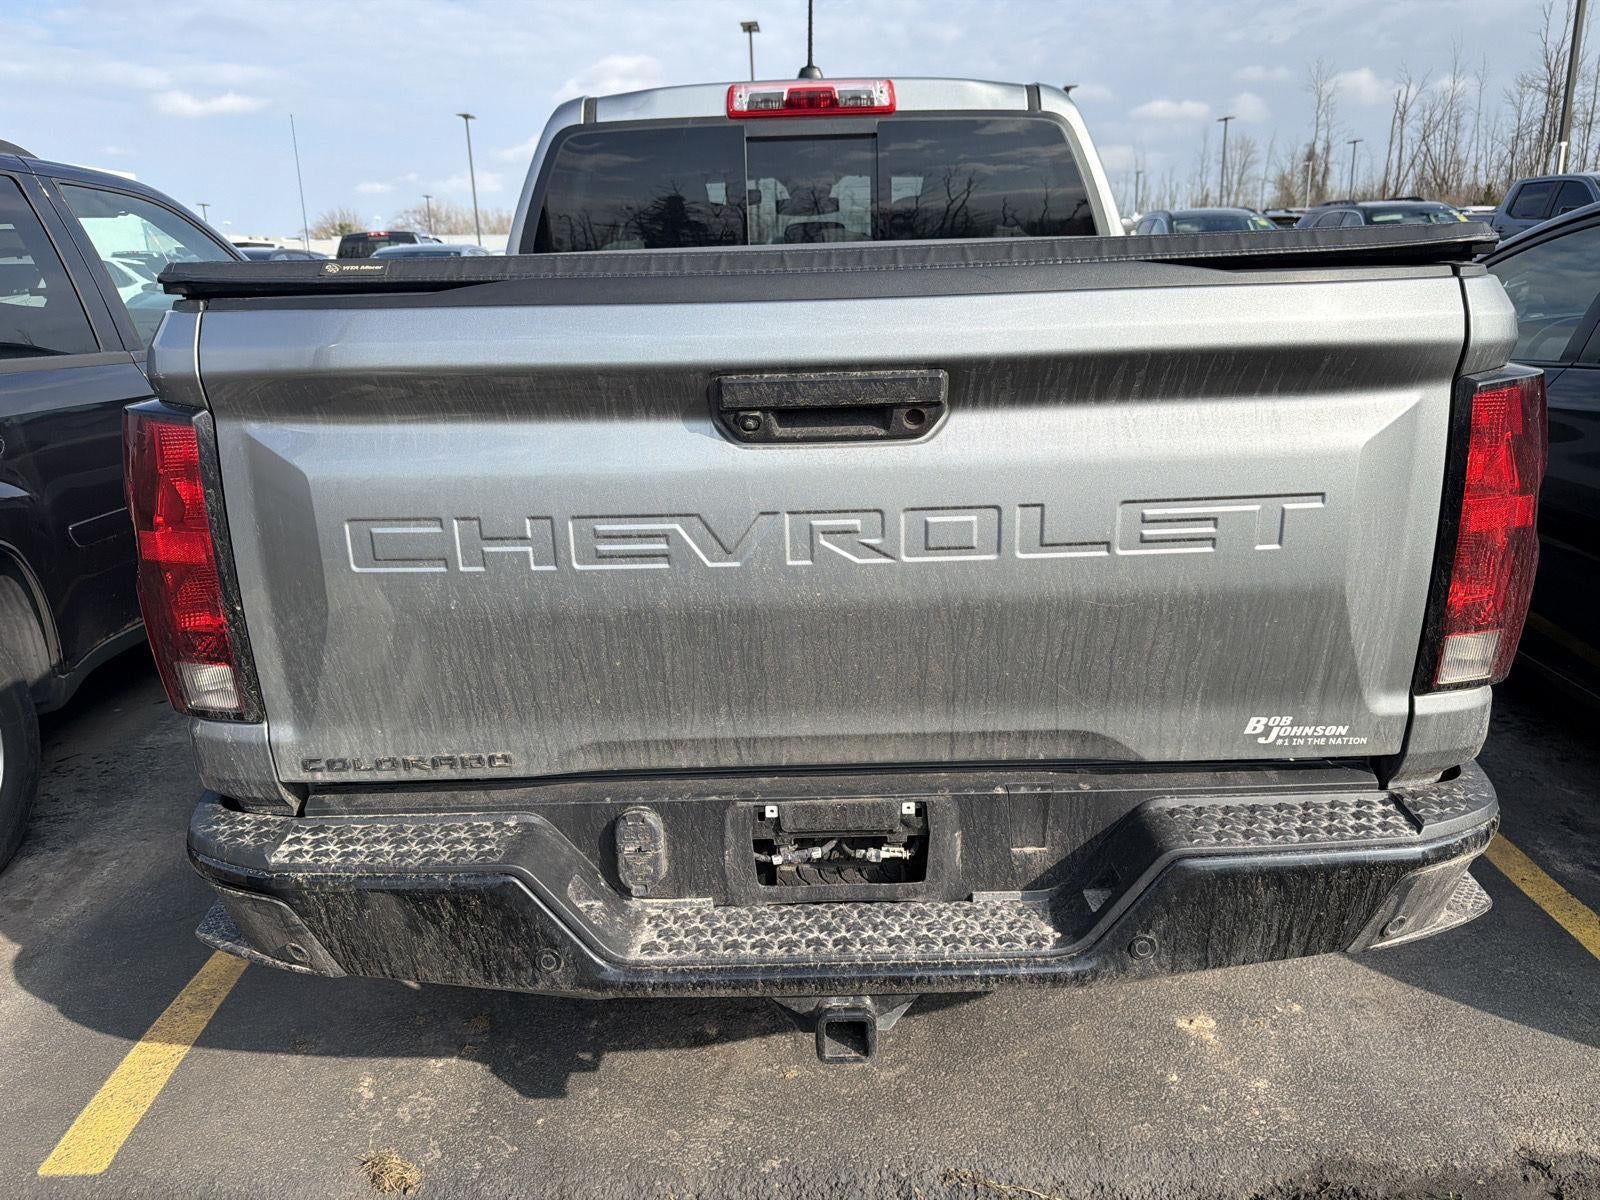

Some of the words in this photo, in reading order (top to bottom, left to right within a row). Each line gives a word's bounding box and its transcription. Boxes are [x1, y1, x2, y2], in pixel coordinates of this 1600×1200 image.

[344, 492, 1326, 573] CHEVROLET
[1244, 716, 1293, 735] BOB
[1257, 725, 1349, 744] JOHNSON
[1276, 738, 1289, 746] #1
[1292, 738, 1305, 746] IN
[1307, 737, 1326, 745] THE
[1328, 737, 1367, 745] NATION
[302, 752, 512, 773] COLORADO
